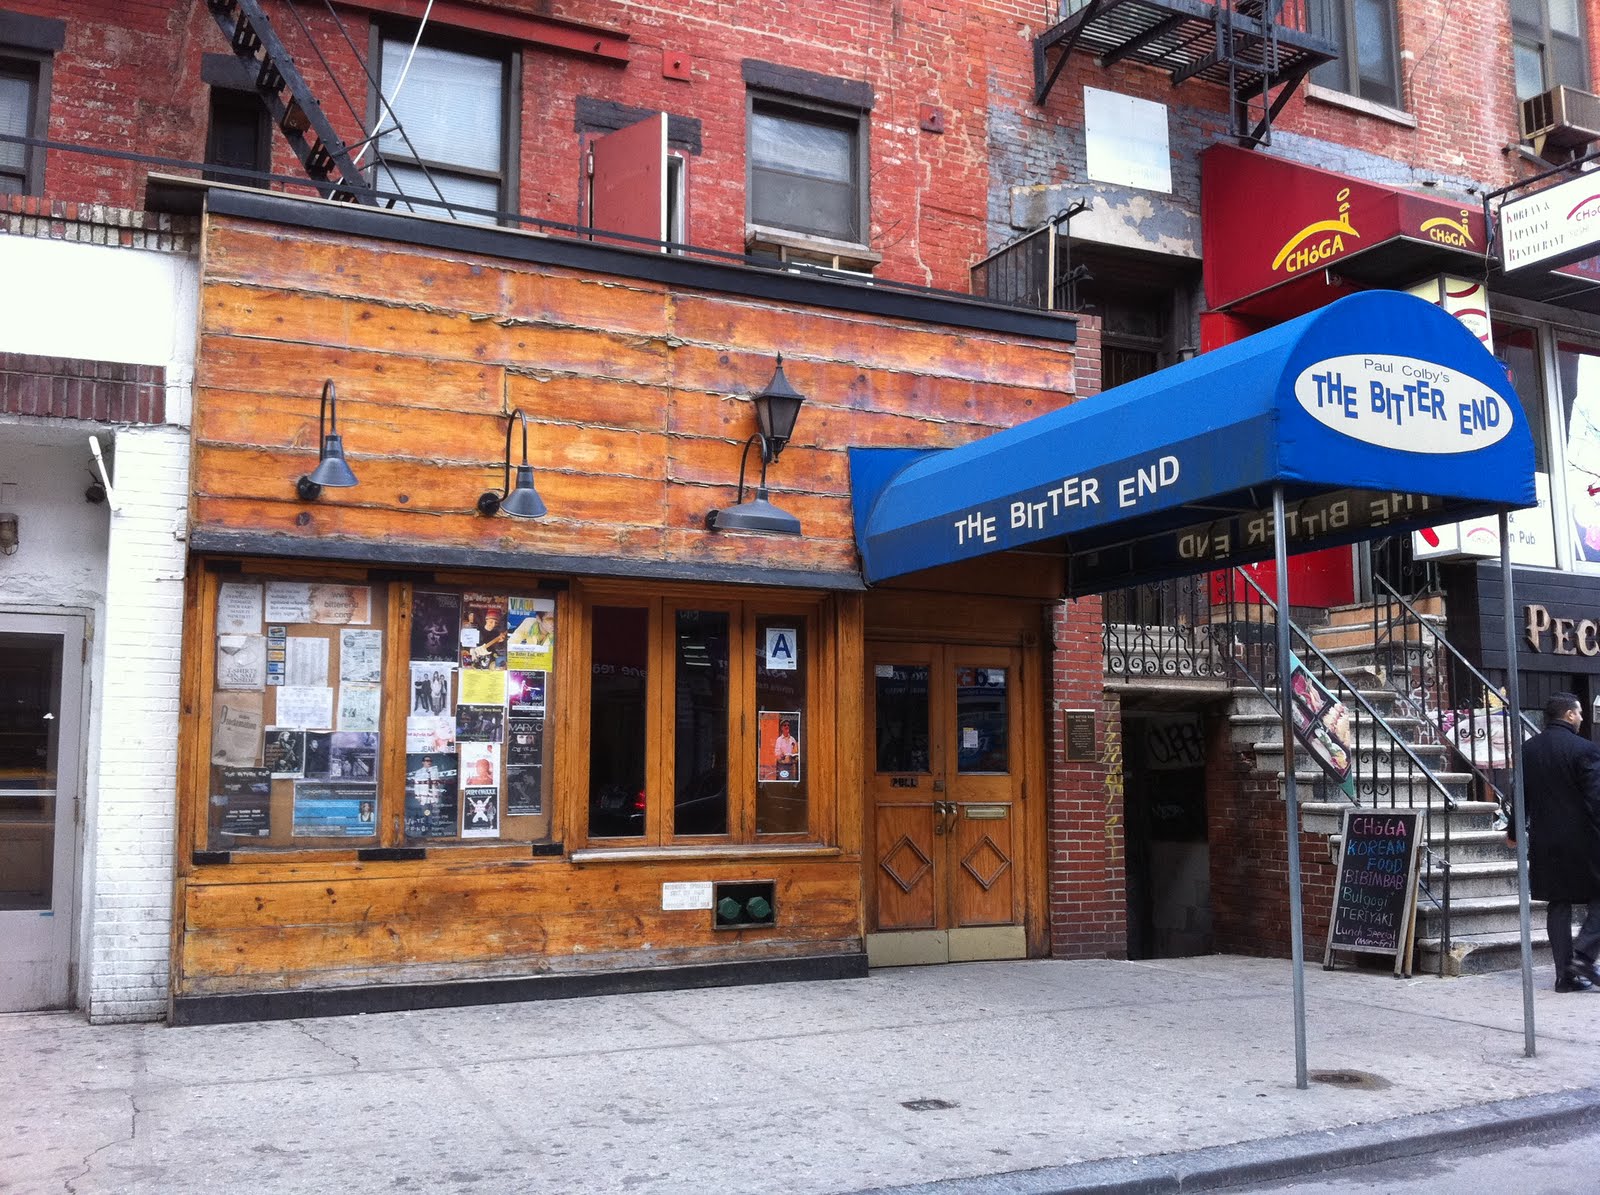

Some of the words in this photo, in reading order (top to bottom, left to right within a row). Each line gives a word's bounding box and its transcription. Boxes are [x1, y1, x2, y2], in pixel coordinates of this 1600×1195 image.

[1364, 358, 1394, 374] Paul
[1401, 364, 1450, 384] Colby's
[1312, 371, 1359, 420] THE
[1369, 380, 1448, 426] BITTER
[1458, 396, 1501, 436] END
[954, 511, 997, 545] THE
[1010, 477, 1101, 530] BITTER
[1118, 455, 1180, 508] END
[1519, 531, 1536, 545] Pub
[771, 633, 792, 658] A
[1347, 839, 1406, 856] KOREAN
[1367, 857, 1403, 874] FOOD
[1339, 906, 1394, 927] TERIYAKI
[1335, 919, 1363, 937] Lunch
[1366, 927, 1397, 941] Special
